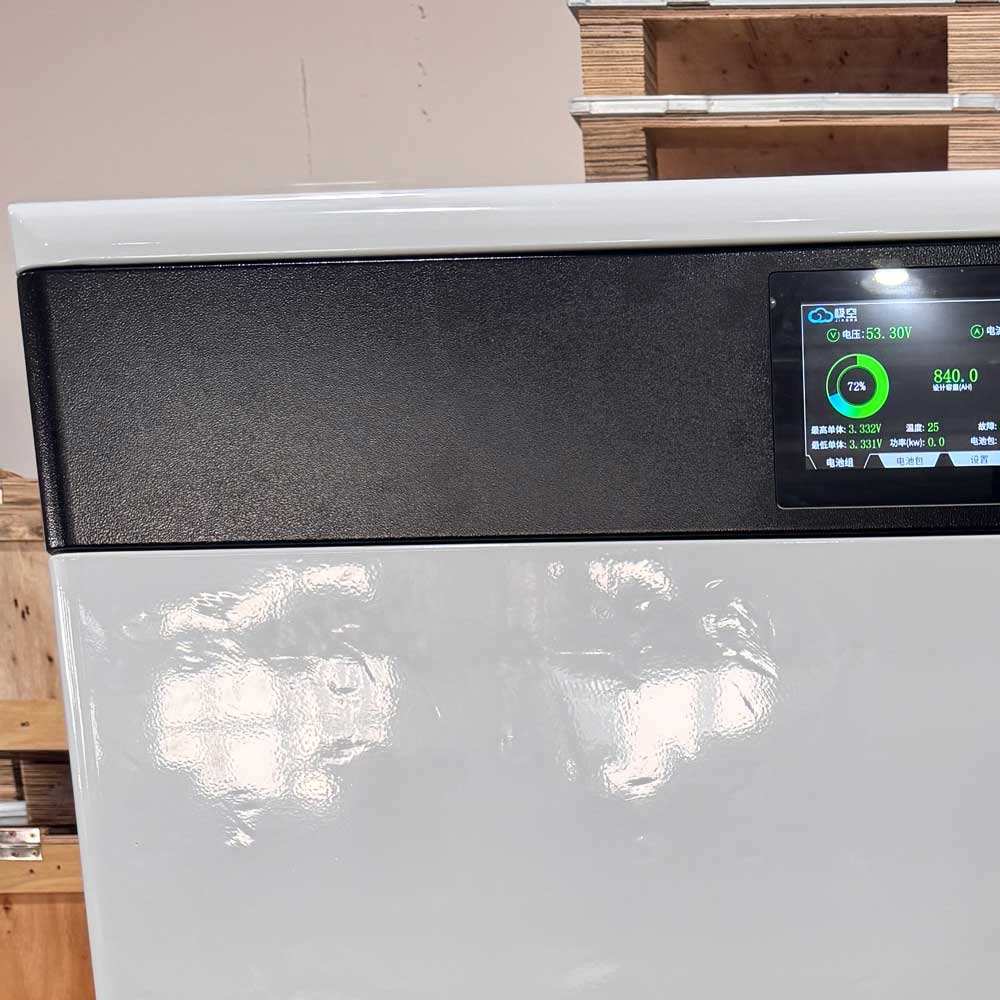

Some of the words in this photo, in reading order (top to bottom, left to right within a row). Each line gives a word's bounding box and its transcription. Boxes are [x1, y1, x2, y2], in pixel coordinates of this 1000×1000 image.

[933, 368, 978, 383] 840.0
[847, 381, 867, 391] 72%
[848, 423, 882, 434] 3.332V
[927, 422, 939, 432] 25
[849, 438, 883, 449] 3.331V
[927, 437, 945, 448] 0.0
[826, 457, 854, 468] 电池组
